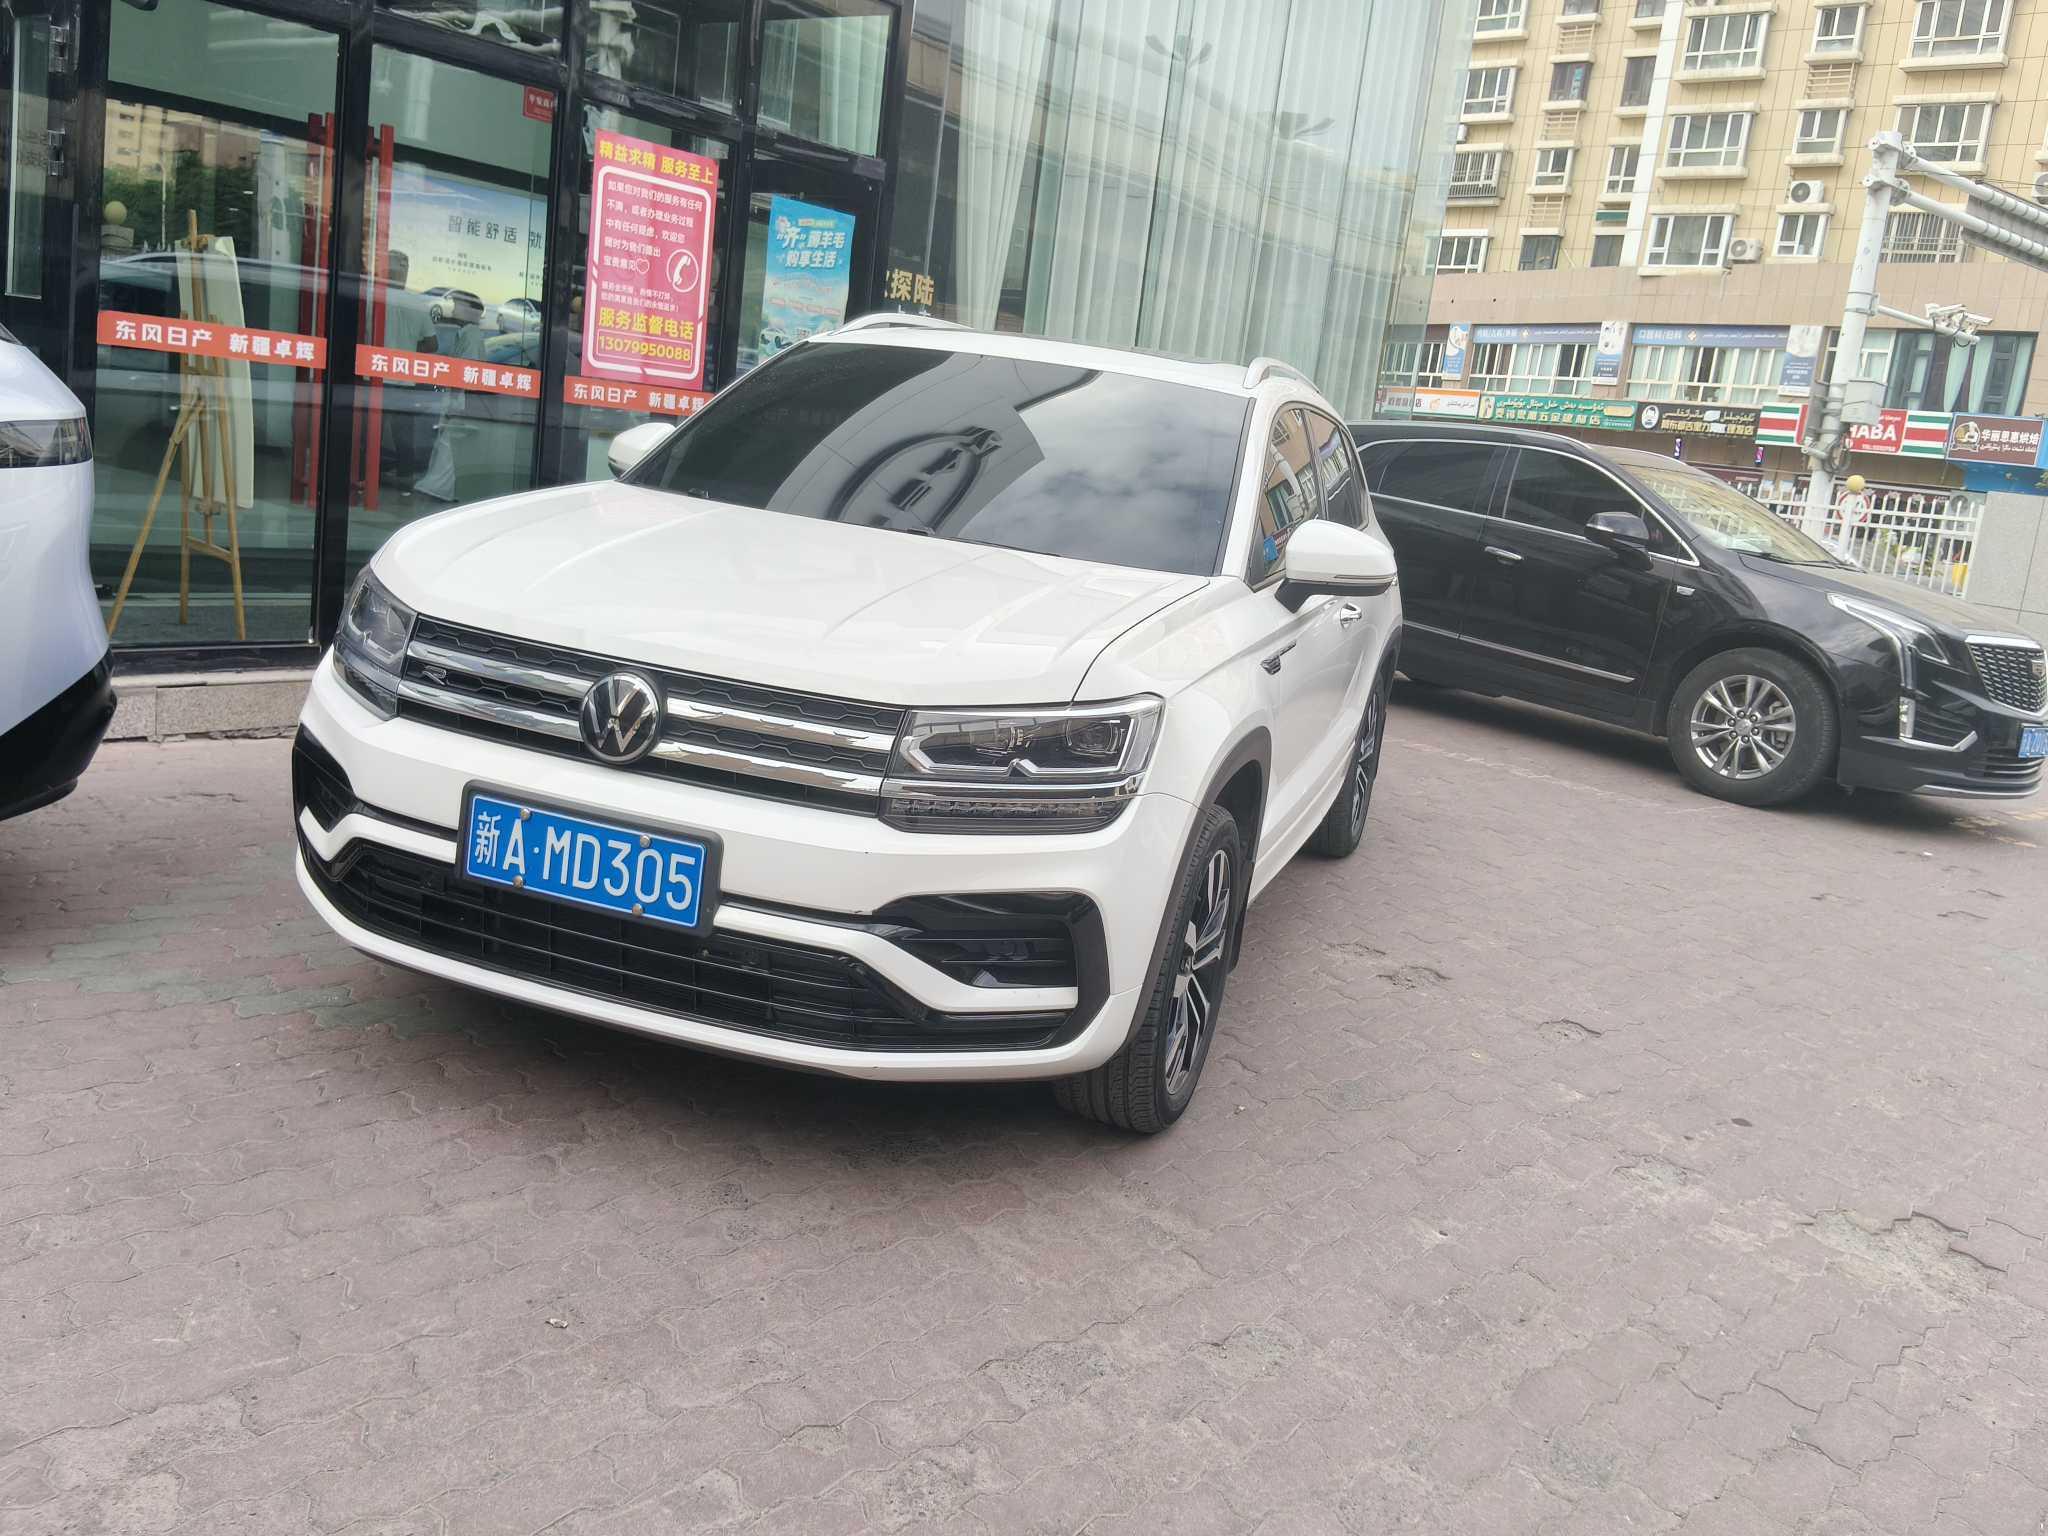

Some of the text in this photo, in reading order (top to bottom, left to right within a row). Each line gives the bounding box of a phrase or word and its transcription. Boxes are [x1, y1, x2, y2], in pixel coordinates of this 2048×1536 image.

[600, 140, 713, 184] 精益求精 服务至上
[607, 180, 703, 212] 如果您对我们的服务有任何
[448, 215, 518, 244] 智能舒适
[604, 236, 661, 257] 随时为我们提出
[784, 250, 838, 268] 购享生活
[603, 255, 637, 272] 宝贵意见
[884, 268, 935, 306] 探陆
[599, 307, 694, 340] 服务监督电话
[115, 319, 314, 361] 东风日产 新疆卓辉
[599, 335, 691, 361] 13079950088
[371, 354, 532, 392] 东风日产 新疆卓辉
[573, 383, 705, 411] 东风日产 新疆卓辉
[474, 810, 696, 911] 新A·MD305
